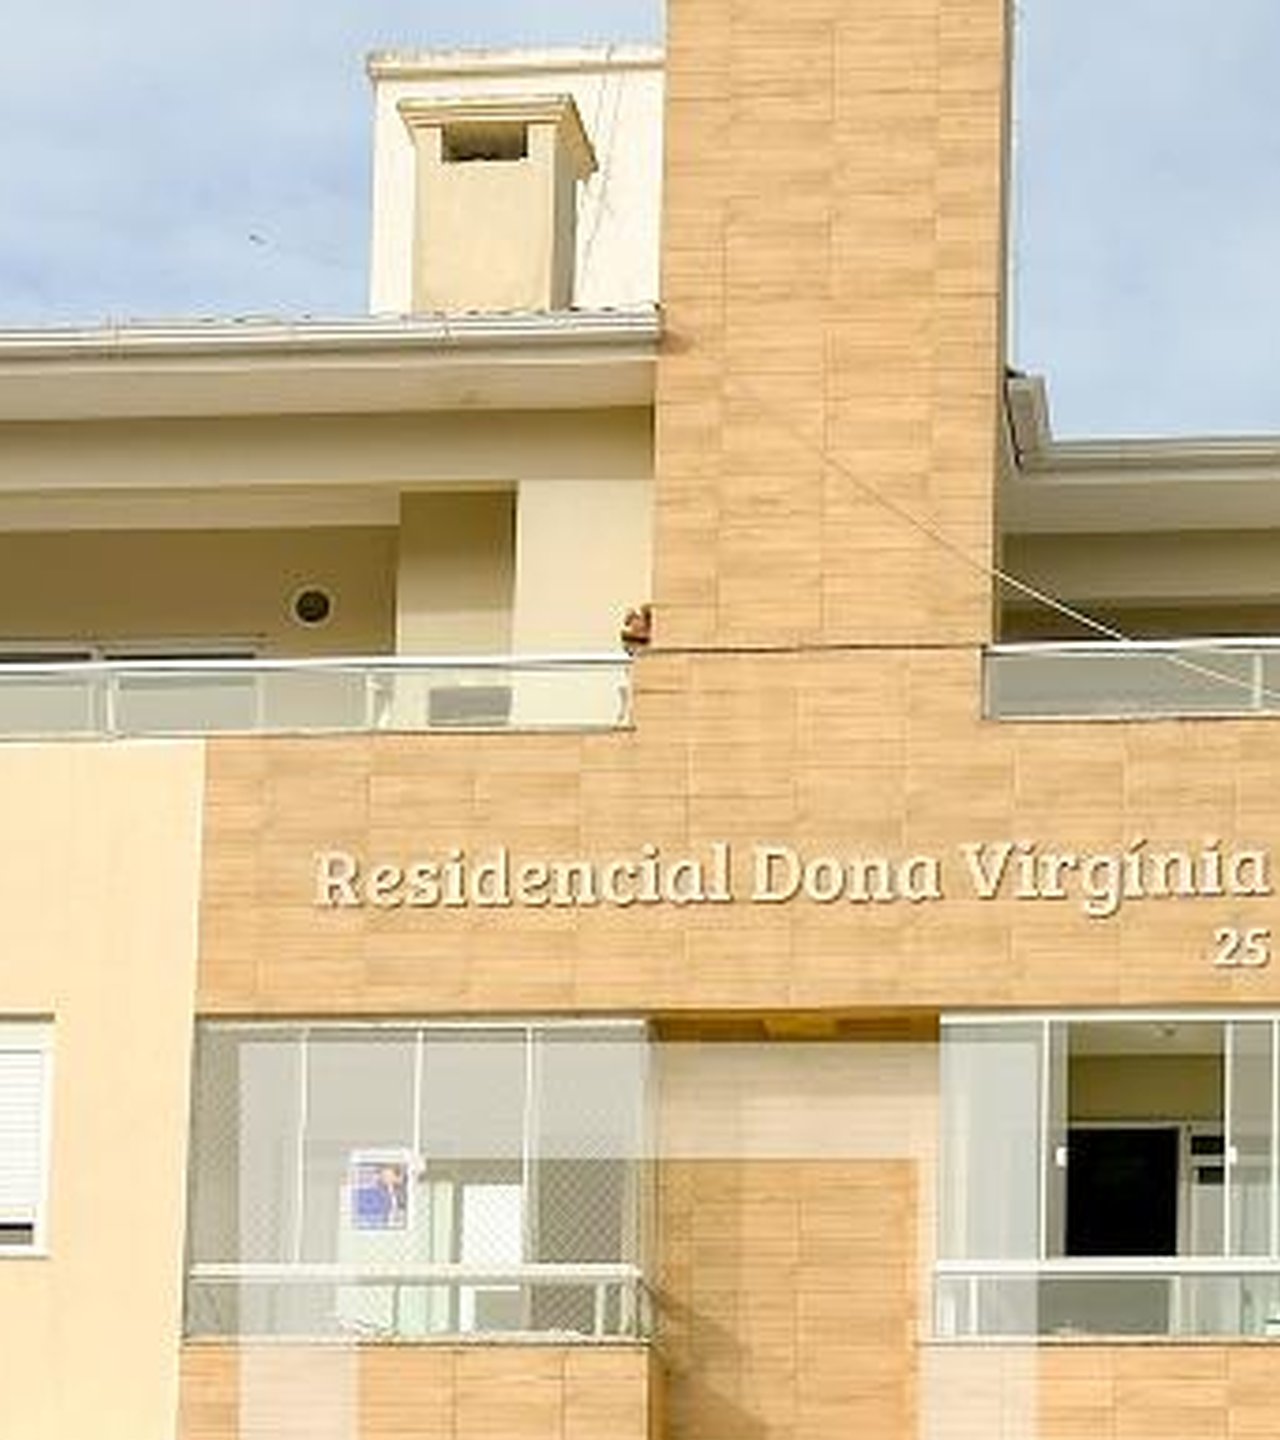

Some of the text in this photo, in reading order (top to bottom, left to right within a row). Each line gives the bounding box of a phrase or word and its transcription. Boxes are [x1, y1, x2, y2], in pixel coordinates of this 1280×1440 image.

[313, 838, 1273, 917] Residencial Dona Virgínia
[1213, 927, 1271, 967] 25
